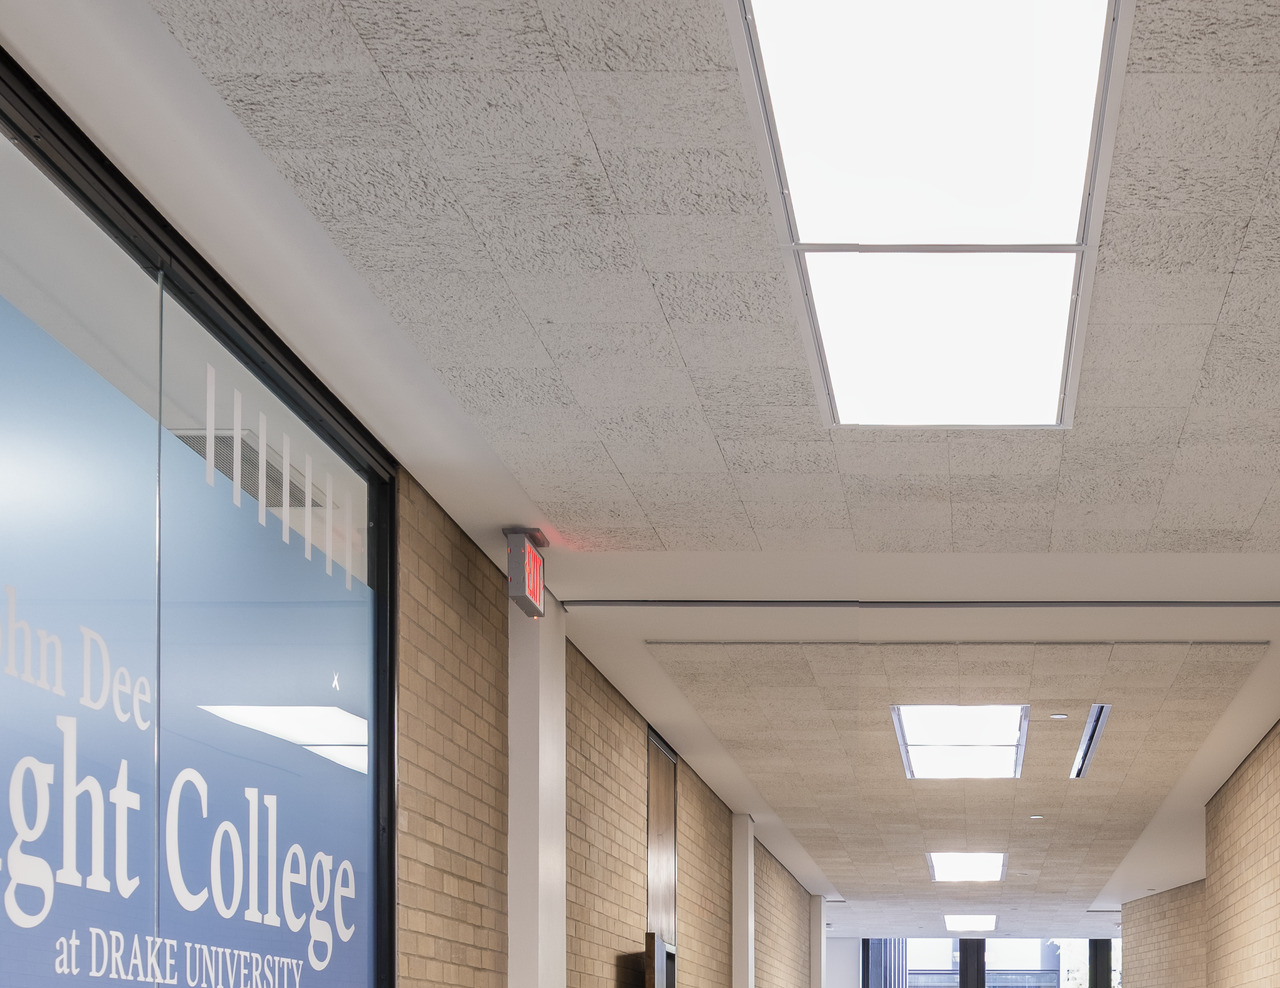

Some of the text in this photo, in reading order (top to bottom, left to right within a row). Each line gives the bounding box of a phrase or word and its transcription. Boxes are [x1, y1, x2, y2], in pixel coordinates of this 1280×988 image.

[0, 584, 151, 731] hn Dee
[0, 715, 355, 971] ght College
[55, 929, 80, 975] at
[89, 927, 178, 985] DRAKE
